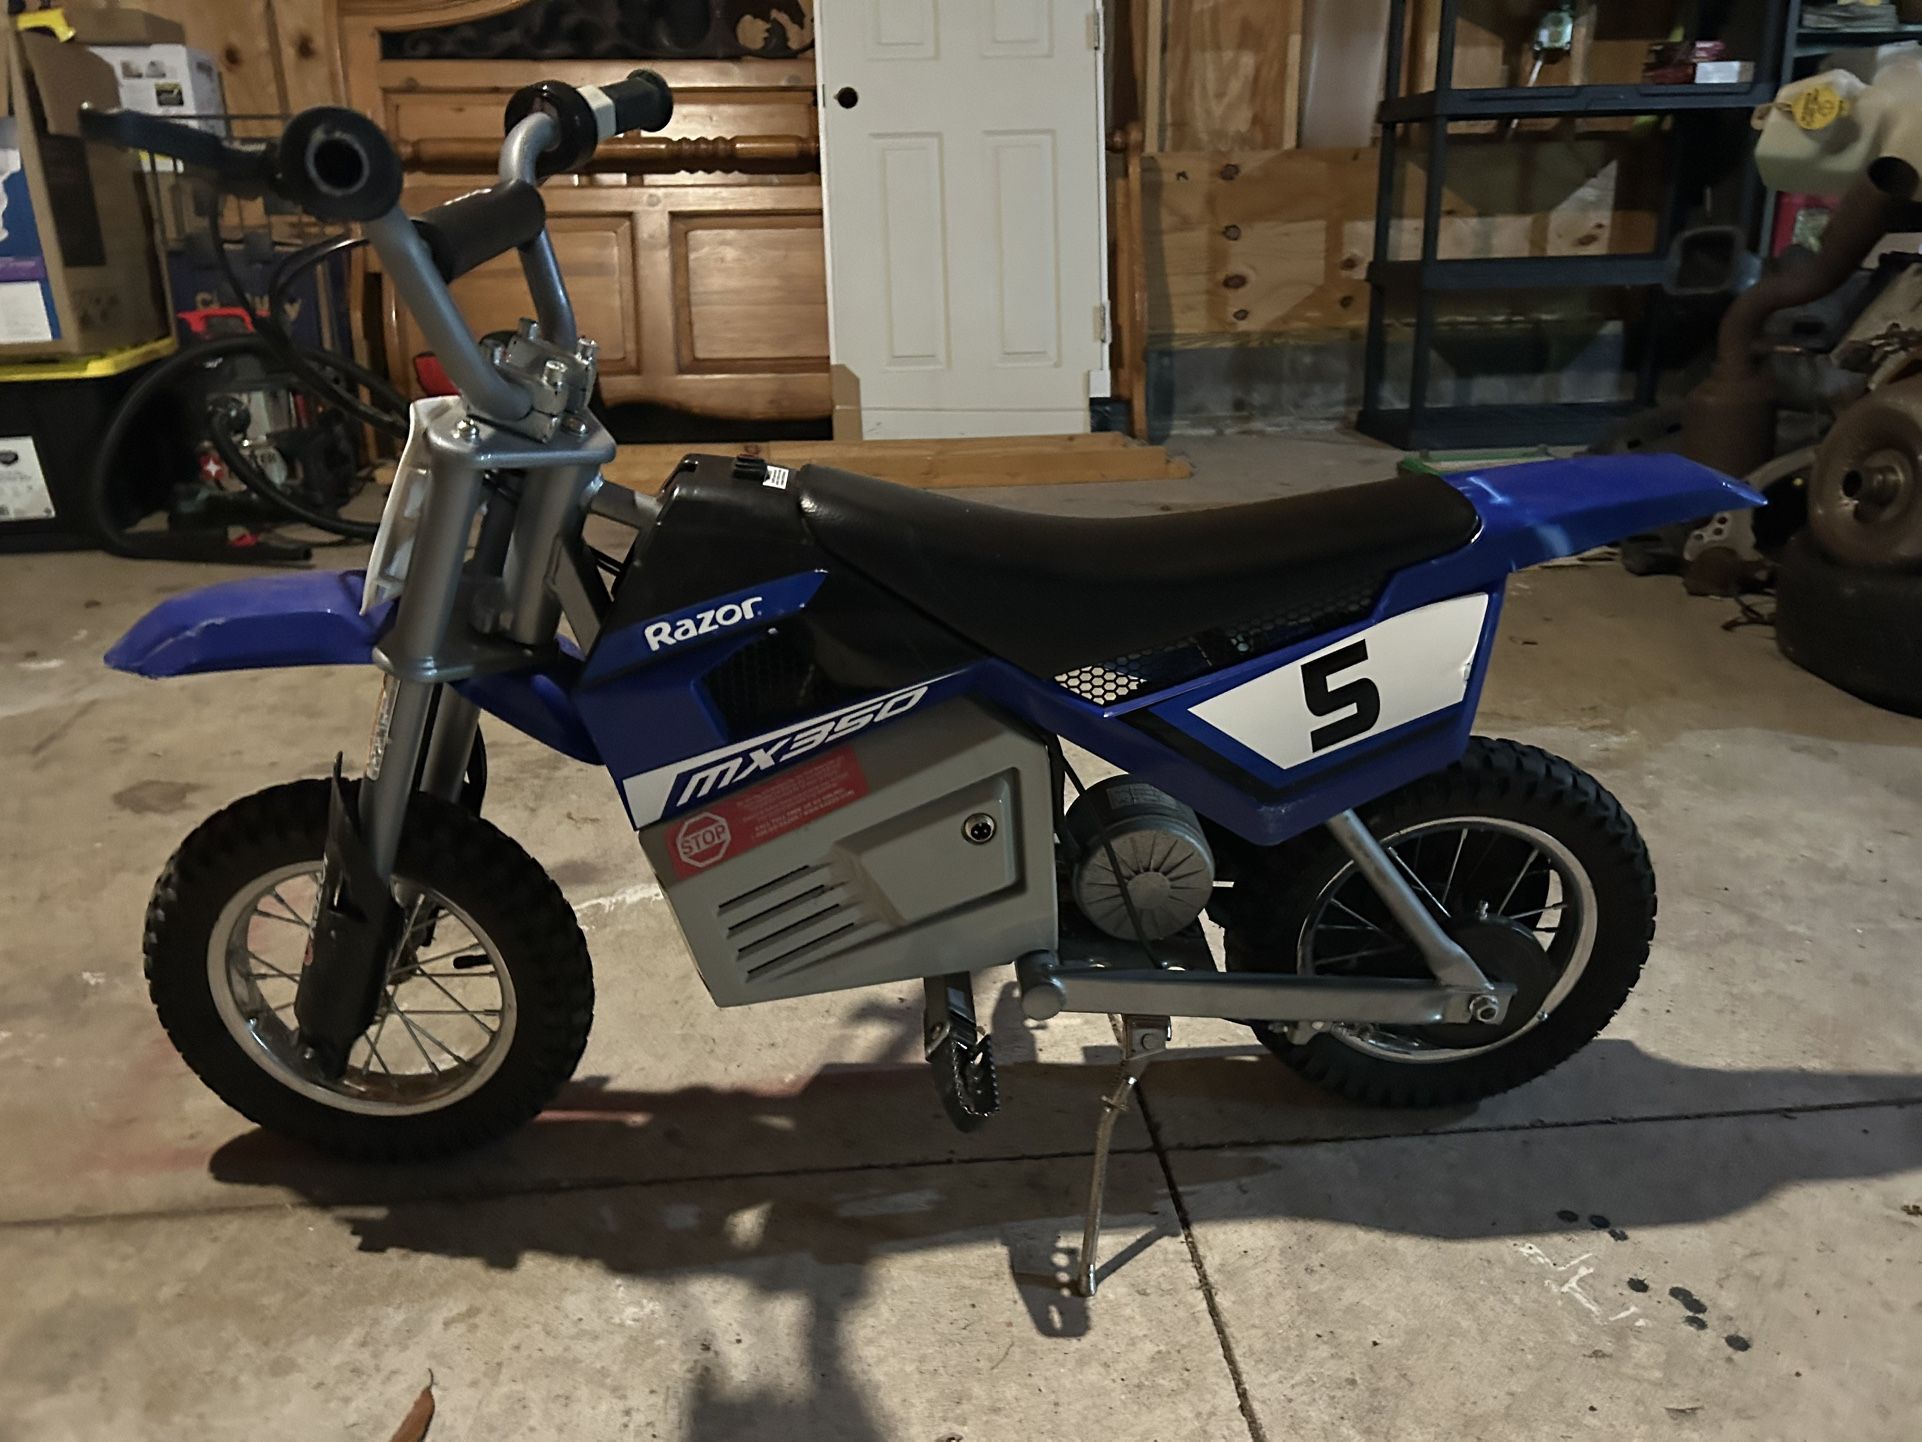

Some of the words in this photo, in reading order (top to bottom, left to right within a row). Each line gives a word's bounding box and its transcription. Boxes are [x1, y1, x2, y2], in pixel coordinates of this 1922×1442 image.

[644, 596, 763, 652] Razor
[1300, 638, 1381, 754] 5
[680, 824, 726, 856] STOP
